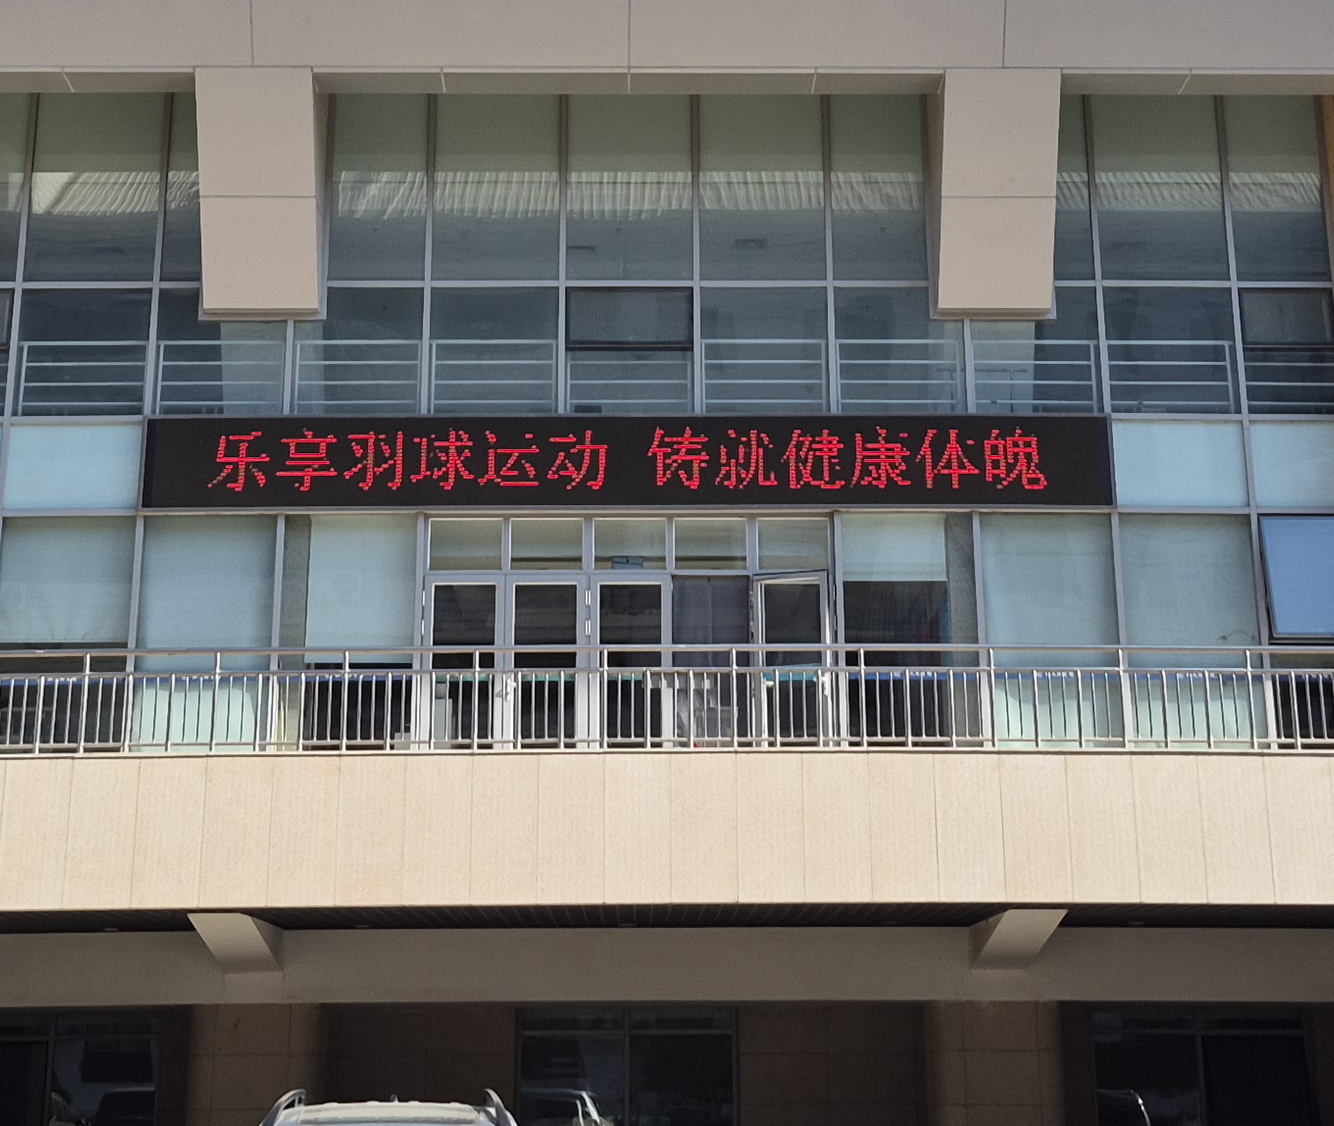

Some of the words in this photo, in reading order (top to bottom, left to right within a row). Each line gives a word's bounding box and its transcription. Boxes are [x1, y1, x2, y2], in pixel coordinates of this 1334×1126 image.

[208, 428, 608, 491] 乐享羽球运动
[646, 426, 1048, 490] 铸就健康体魄
